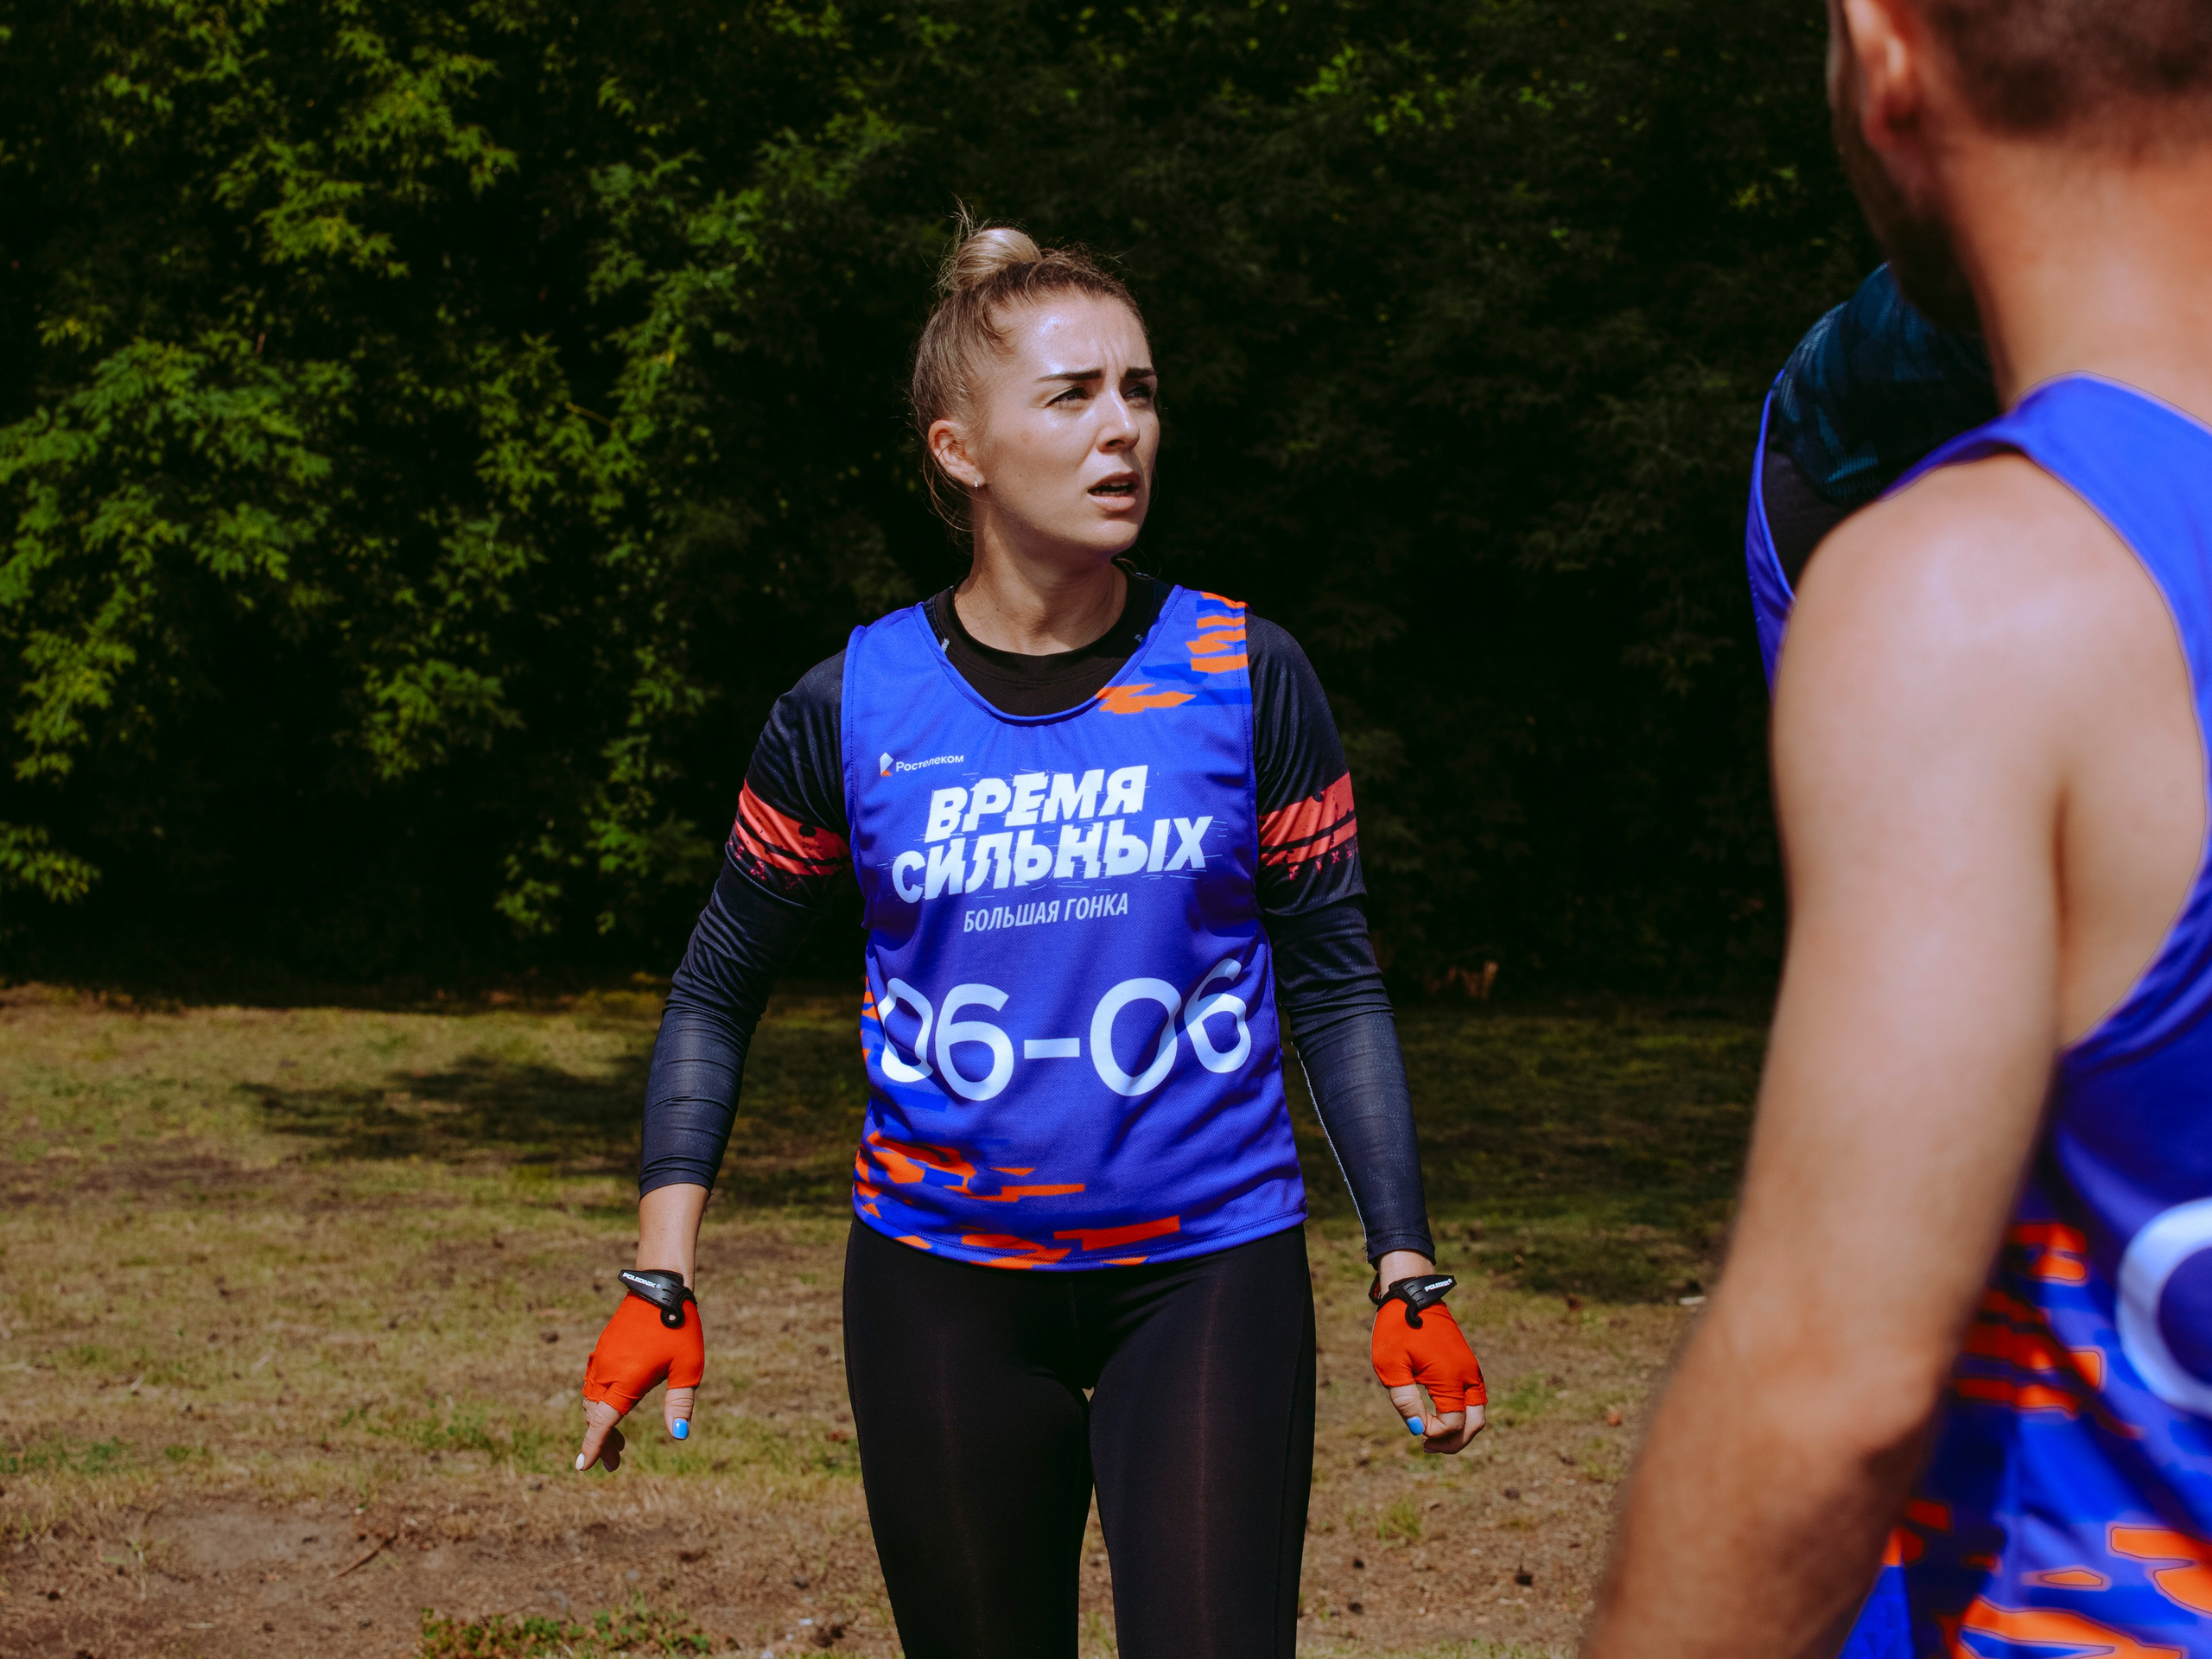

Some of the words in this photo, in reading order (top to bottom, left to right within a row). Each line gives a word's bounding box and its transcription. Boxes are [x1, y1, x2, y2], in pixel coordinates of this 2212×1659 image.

[895, 754, 964, 772] Ростелеком
[924, 765, 1149, 843] ВРЕМЯ
[891, 815, 1214, 904] СИЛЬНЫХ
[963, 899, 1059, 932] БОЛЬШАЯ
[1063, 893, 1128, 922] ГОНКА
[877, 957, 1252, 1102] 06-06
